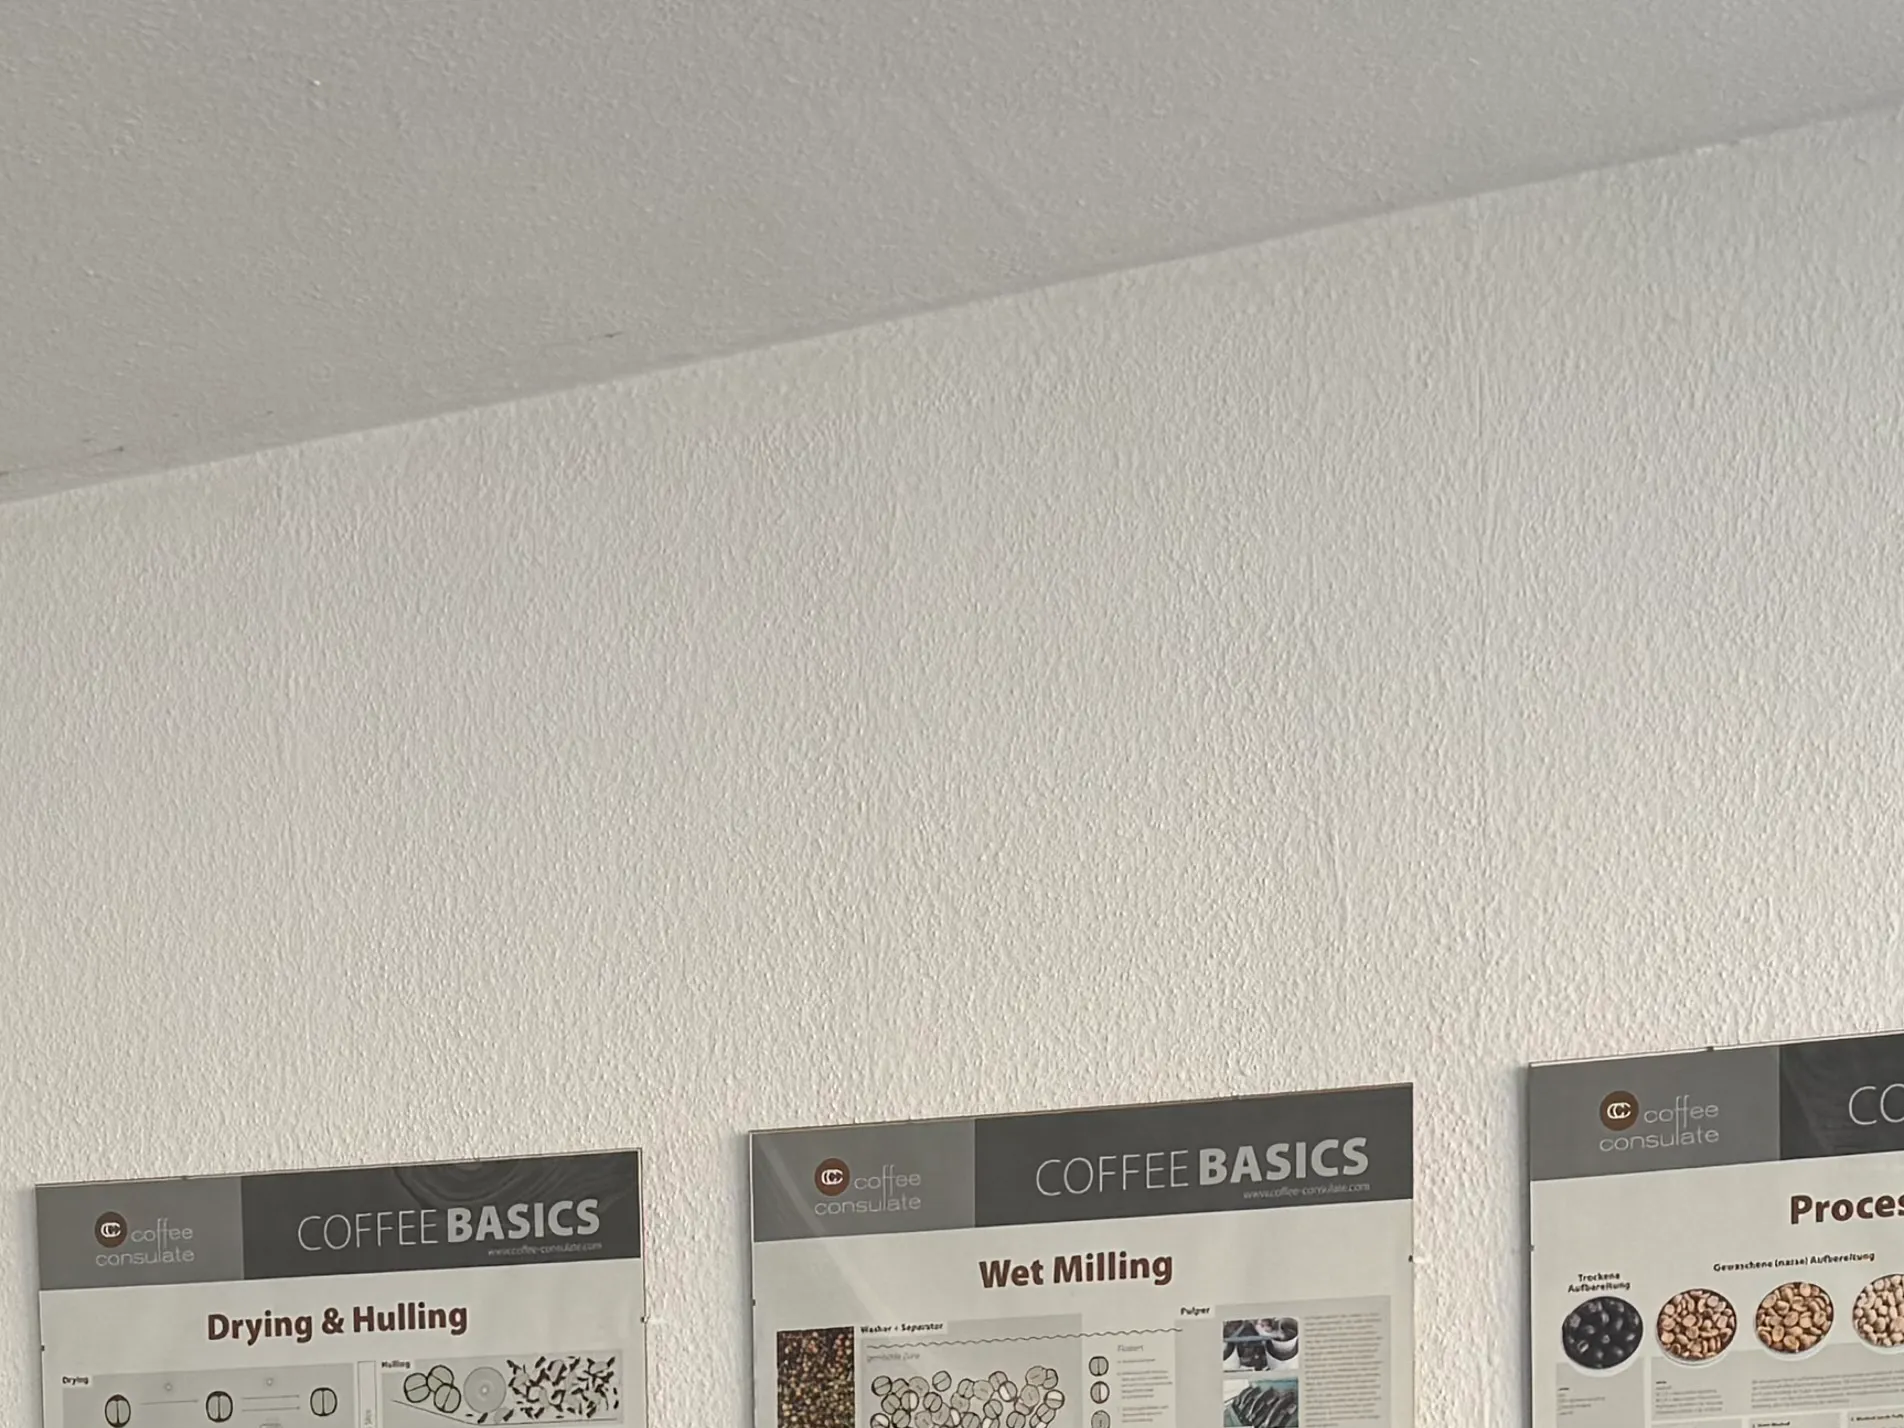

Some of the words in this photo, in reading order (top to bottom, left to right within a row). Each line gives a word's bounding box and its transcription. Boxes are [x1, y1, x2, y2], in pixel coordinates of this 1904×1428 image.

[1643, 1093, 1720, 1131] coffee
[1599, 1125, 1720, 1153] consulate
[854, 1164, 921, 1197] coffee
[1036, 1150, 1190, 1196] COFFEE
[1199, 1137, 1369, 1185] BASICS
[815, 1192, 921, 1216] consulate
[131, 1218, 194, 1251] coffee
[297, 1210, 439, 1251] COFFEE
[446, 1199, 600, 1243] BASICS
[96, 1247, 195, 1267] consulate
[979, 1259, 1045, 1289] Wet
[1053, 1251, 1174, 1287] Milling
[1810, 1252, 1875, 1266] Aufbereitung
[207, 1310, 313, 1346] Drying
[322, 1309, 344, 1334] &
[353, 1302, 468, 1336] Hulling
